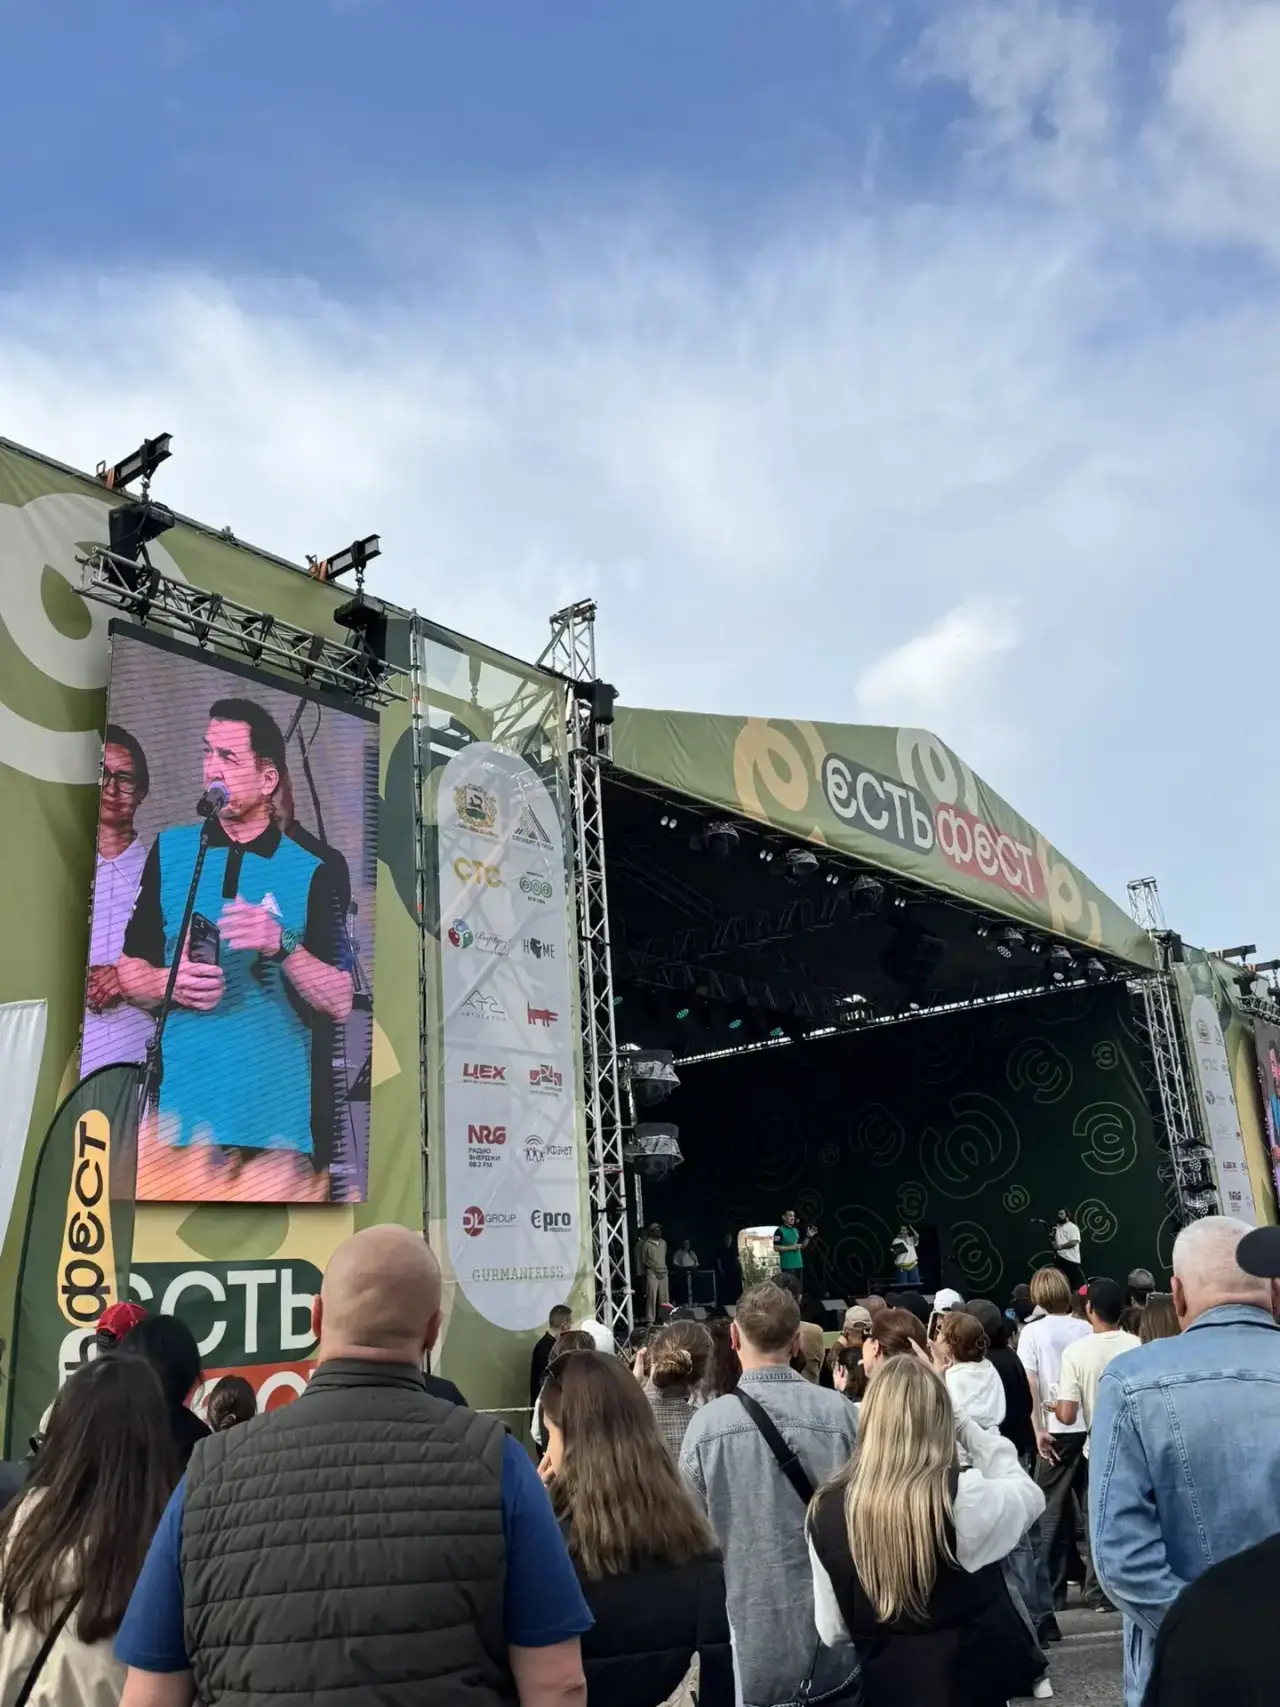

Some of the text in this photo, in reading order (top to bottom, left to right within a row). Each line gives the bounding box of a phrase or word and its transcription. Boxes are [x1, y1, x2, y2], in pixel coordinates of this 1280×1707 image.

[468, 1125, 506, 1145] NRG
[485, 1213, 516, 1223] GROUP
[472, 1266, 564, 1282] GURMANFRESH
[128, 1268, 320, 1357] СТЬ
